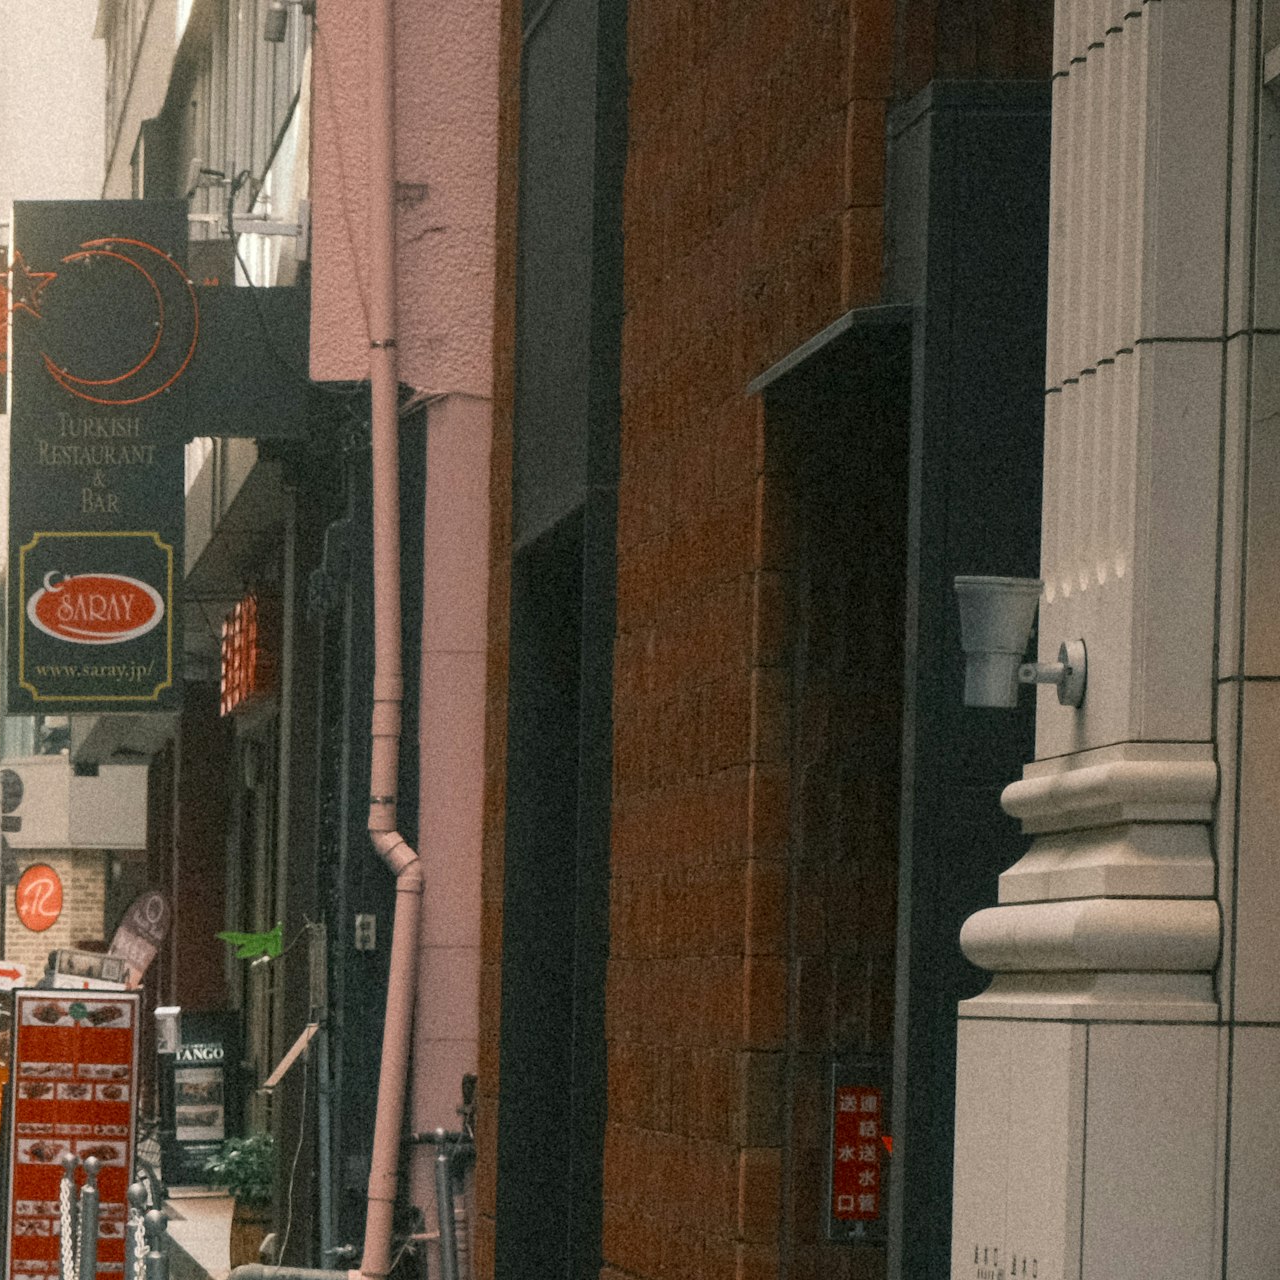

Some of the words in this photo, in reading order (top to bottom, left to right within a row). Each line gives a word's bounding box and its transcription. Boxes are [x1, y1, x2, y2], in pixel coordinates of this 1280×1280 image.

[93, 468, 106, 488] &
[57, 593, 135, 621] SARAY
[35, 660, 154, 681] www.saray.jp/
[175, 1047, 225, 1061] TANGO
[838, 1094, 858, 1212] 送水口
